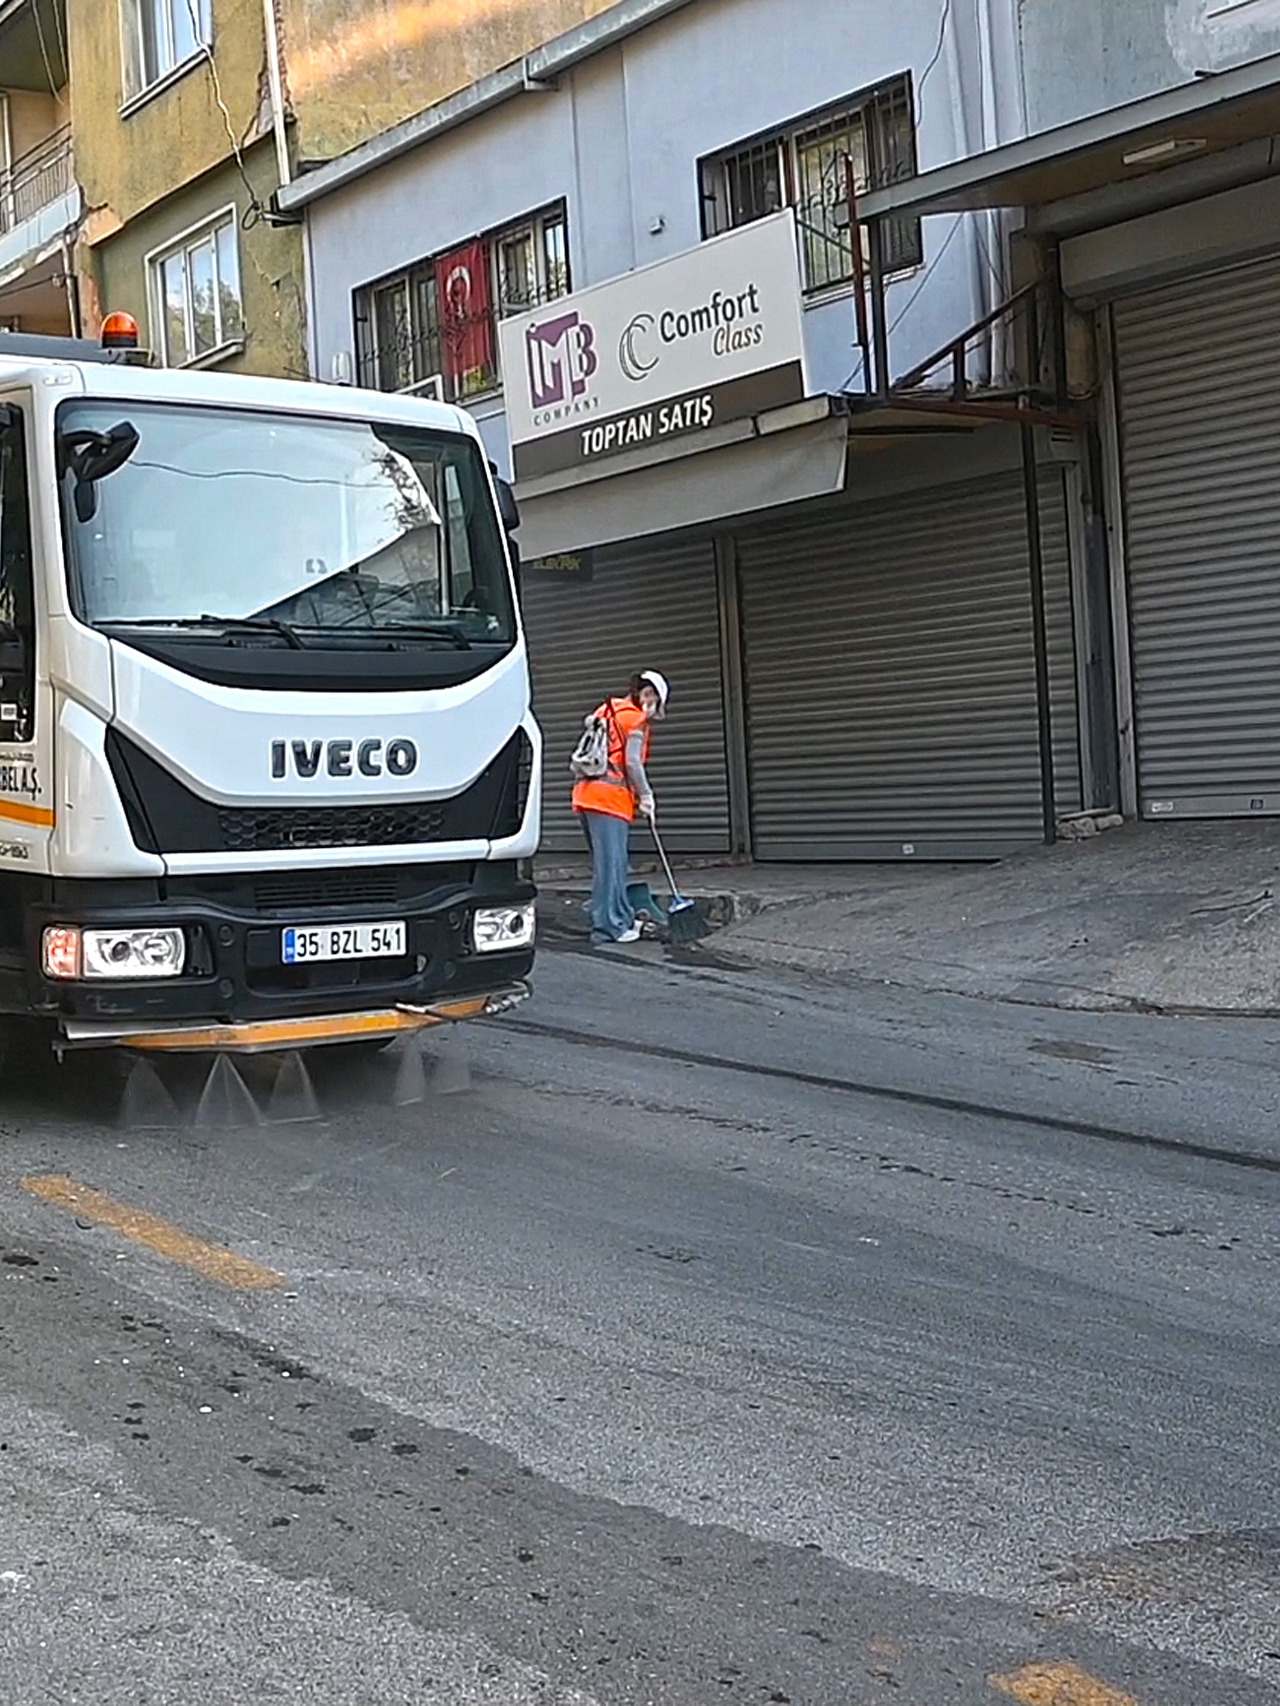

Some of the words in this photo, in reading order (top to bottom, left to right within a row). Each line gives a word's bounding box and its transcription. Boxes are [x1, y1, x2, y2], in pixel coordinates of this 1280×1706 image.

[660, 283, 760, 343] Comfort
[713, 323, 763, 356] Class
[533, 396, 599, 426] COMPANY
[581, 411, 652, 456] TOPTAN
[658, 394, 714, 430] SATIŞ
[271, 738, 418, 779] IVECO
[296, 932, 320, 957] 35
[330, 930, 363, 955] BZL
[371, 926, 401, 951] 541
